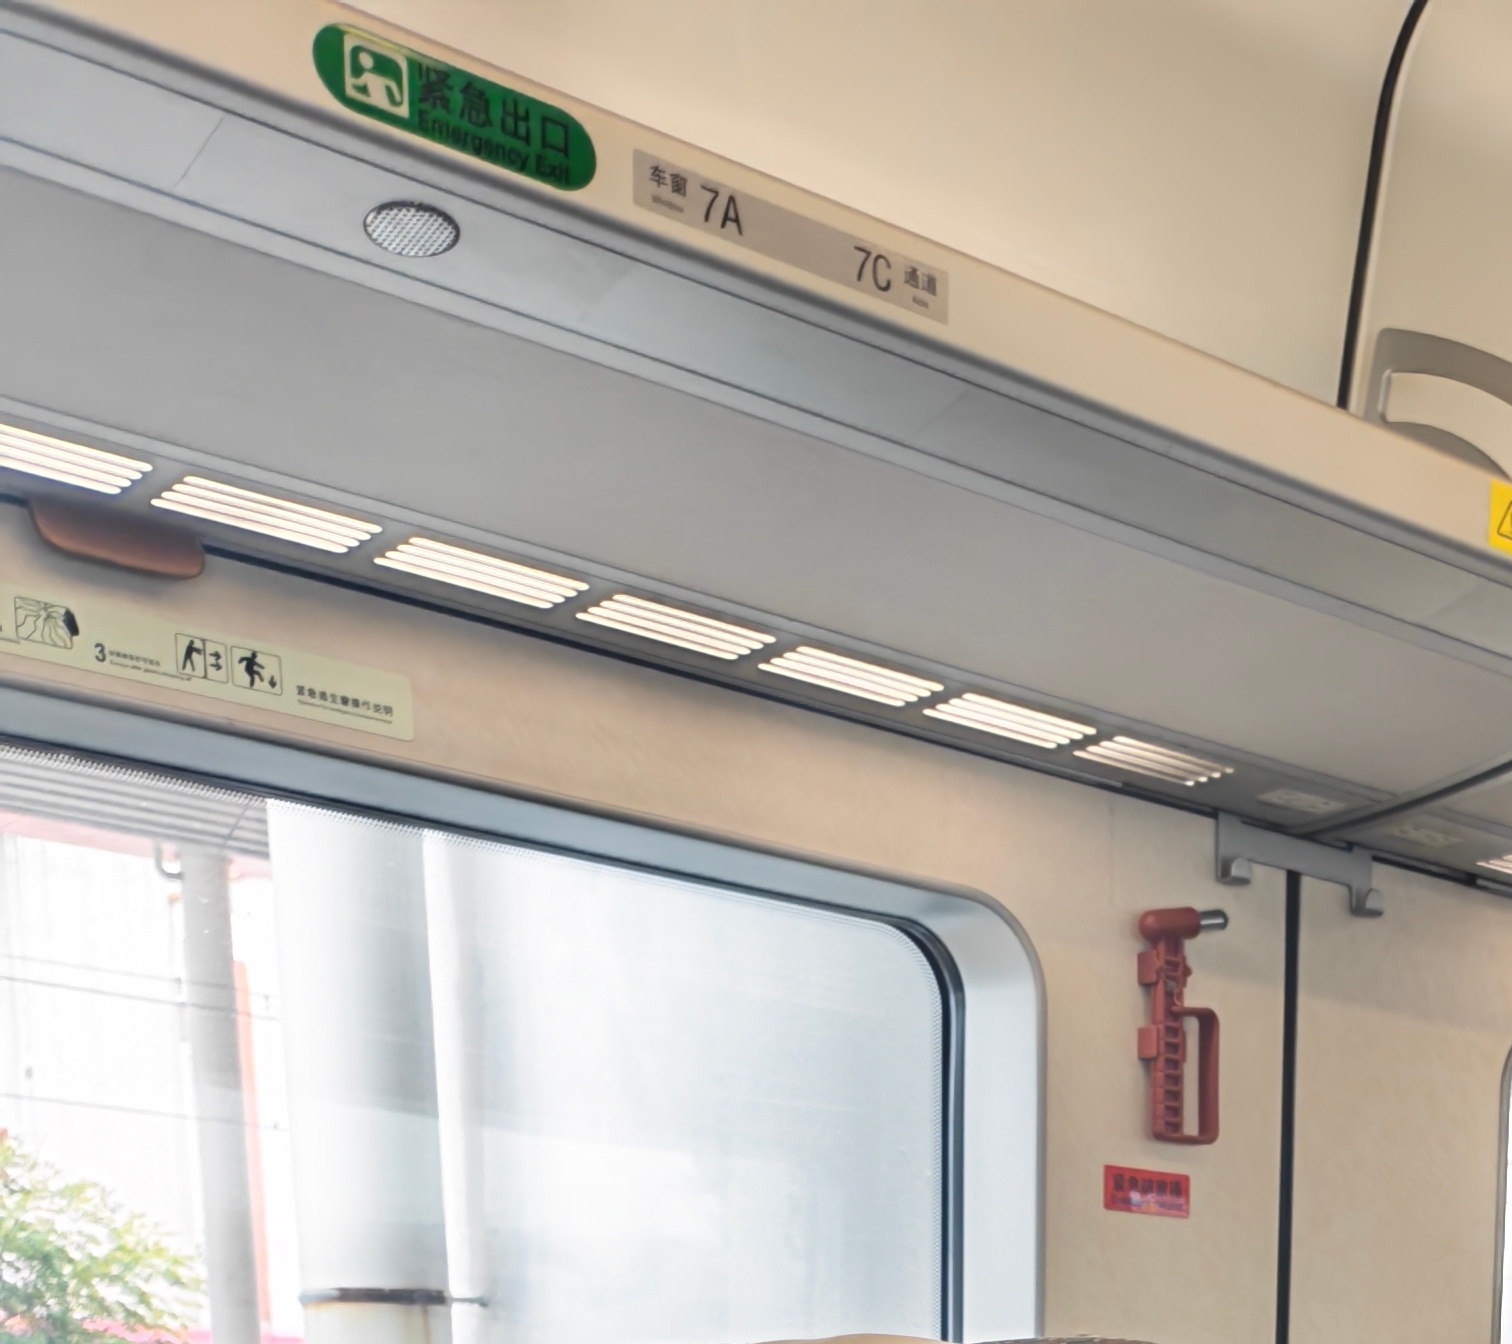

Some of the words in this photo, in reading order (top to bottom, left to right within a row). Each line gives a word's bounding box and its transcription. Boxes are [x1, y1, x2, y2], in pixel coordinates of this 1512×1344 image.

[418, 62, 569, 158] 紧急出口
[418, 110, 529, 172] Emergency
[535, 154, 569, 185] Exit
[649, 164, 688, 197] 车窗
[700, 185, 743, 236] 7A
[853, 245, 891, 292] 7C
[903, 265, 938, 296] 通道
[94, 642, 107, 663] 3
